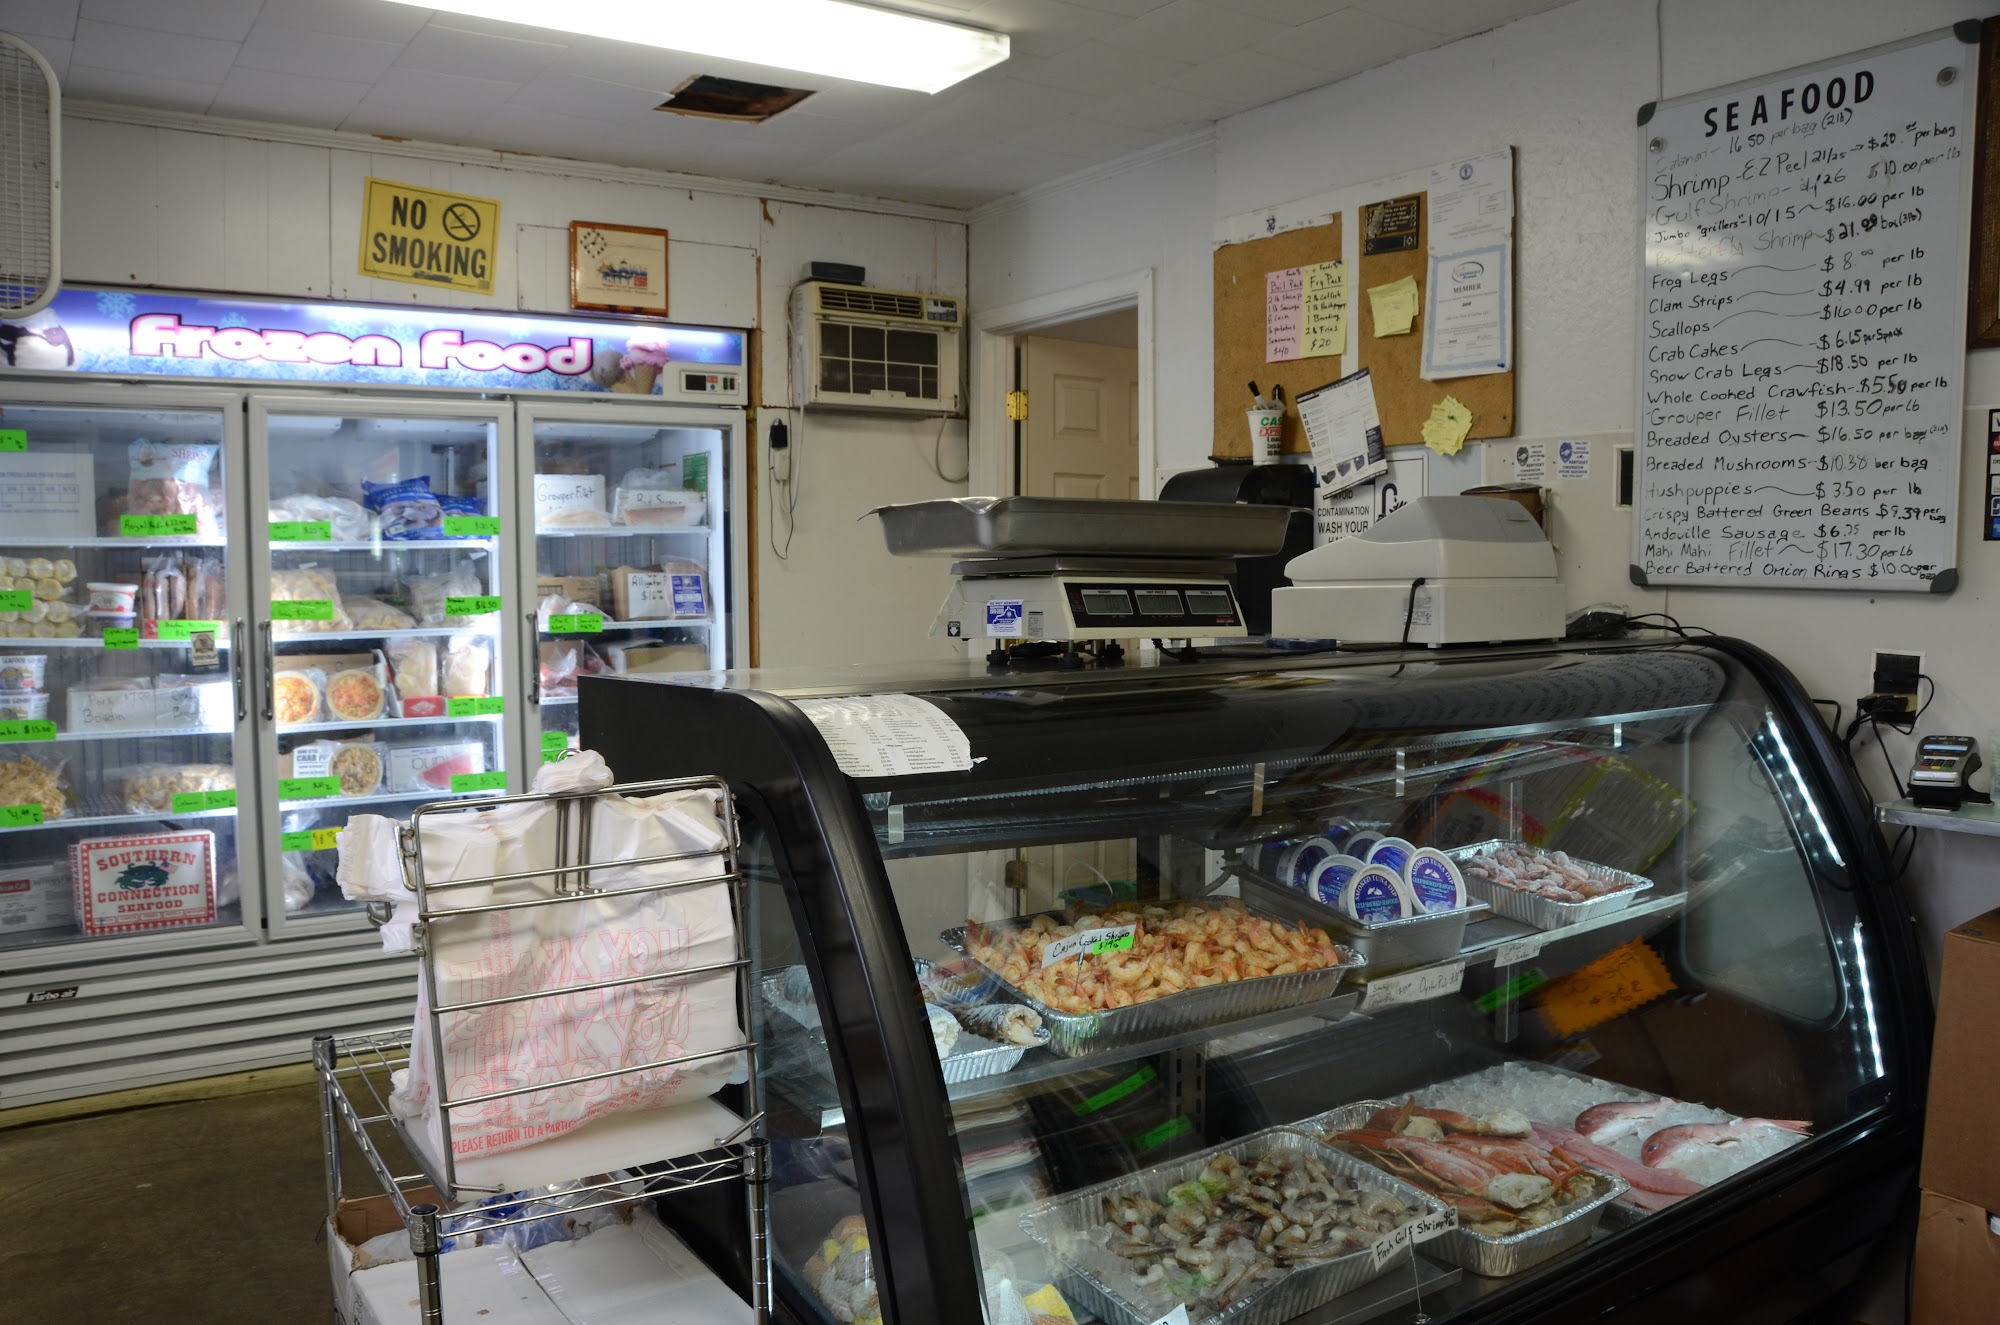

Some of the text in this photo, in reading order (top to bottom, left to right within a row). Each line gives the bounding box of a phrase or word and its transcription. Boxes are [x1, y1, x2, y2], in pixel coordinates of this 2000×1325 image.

[1704, 71, 1874, 137] SEAFOOD
[1729, 133, 1765, 154] 16.50
[1771, 127, 1789, 145] per
[1792, 122, 1817, 139] bag
[1654, 122, 1956, 201] Shrimp Peel 21/25 per bag
[1655, 147, 1960, 226] Gulf Shrimp $10.00 per lb
[391, 195, 427, 230] NO
[1655, 230, 1690, 243] Jumbo
[1749, 205, 1796, 227] 10/15
[1825, 193, 1877, 213] $16.00
[1881, 191, 1905, 208] per
[1911, 185, 1925, 197] lb
[1754, 229, 1813, 251] Shrimp
[372, 231, 487, 279] SMOKING
[1310, 273, 1342, 288] Fry Pack
[1652, 274, 1682, 292] Frog
[1690, 270, 1728, 287] Legs
[1882, 253, 1904, 268] per
[1911, 247, 1925, 260] lb
[1320, 291, 1341, 300] Catfish
[1453, 283, 1482, 294] MEMBER
[1649, 273, 1922, 314] Clam Strips $4.99 per lb
[1319, 325, 1338, 334] Fries
[1649, 297, 1922, 338] Scallops per lb
[1310, 338, 1331, 351] $20
[1649, 342, 1738, 362] Crab Cakes
[1649, 353, 1918, 383] Snow Crab Legs $18.50 per lb
[1647, 390, 1694, 404] Whole
[1700, 386, 1755, 401] Cooked
[1910, 381, 1931, 393] per
[1935, 376, 1948, 388] lb
[1650, 398, 1903, 426] Grouper Fillet $13.50 per
[1647, 430, 1710, 448] Breaded
[1718, 429, 1788, 446] Oysters
[1816, 425, 1873, 443] $16.50
[1879, 431, 1899, 442] per
[1646, 456, 1704, 472] Breaded
[1714, 456, 1807, 471] Mushrooms
[1900, 457, 1928, 473] bag
[537, 483, 575, 502] Grouper
[1332, 489, 1354, 500] AVOID
[1646, 481, 1922, 505] Hushpuppies $3.50 per lb
[1317, 506, 1370, 517] CONTAMINATION
[1645, 505, 1689, 526] Crispy
[1697, 504, 1763, 518] Battered
[1772, 504, 1812, 519] Green
[1821, 503, 1869, 516] Beans
[1923, 507, 1941, 517] per
[1317, 520, 1369, 534] WASH YOUR
[1644, 525, 1906, 544] Andouille Sausage per lb
[1645, 540, 1899, 562] Mahi Mahi Fillet $17.30 per
[1645, 560, 1680, 575] Beer
[1686, 561, 1753, 576] Battered
[1762, 563, 1807, 578] Onion
[1814, 563, 1862, 579] Rings
[1868, 562, 1918, 578] $10.00
[1917, 563, 1937, 573] per
[96, 849, 197, 872] SOUTHERN
[1412, 857, 1454, 885] SMOKED TUNA DIP
[97, 884, 200, 904] CONNECTION
[1355, 875, 1398, 901] SMOKED TUNA DIP
[118, 899, 183, 913] SEAFOOD
[599, 928, 689, 976] YOU
[1053, 931, 1130, 958] Cajun Cooked Shrimp
[31, 989, 76, 1002] Turbo air
[449, 1003, 689, 1078] THANK YOU
[449, 1043, 688, 1110] GRACIAS
[452, 1124, 544, 1154] PLEASE RETURN TO A
[1376, 1220, 1445, 1262] Fresh Gulf Shrimp
